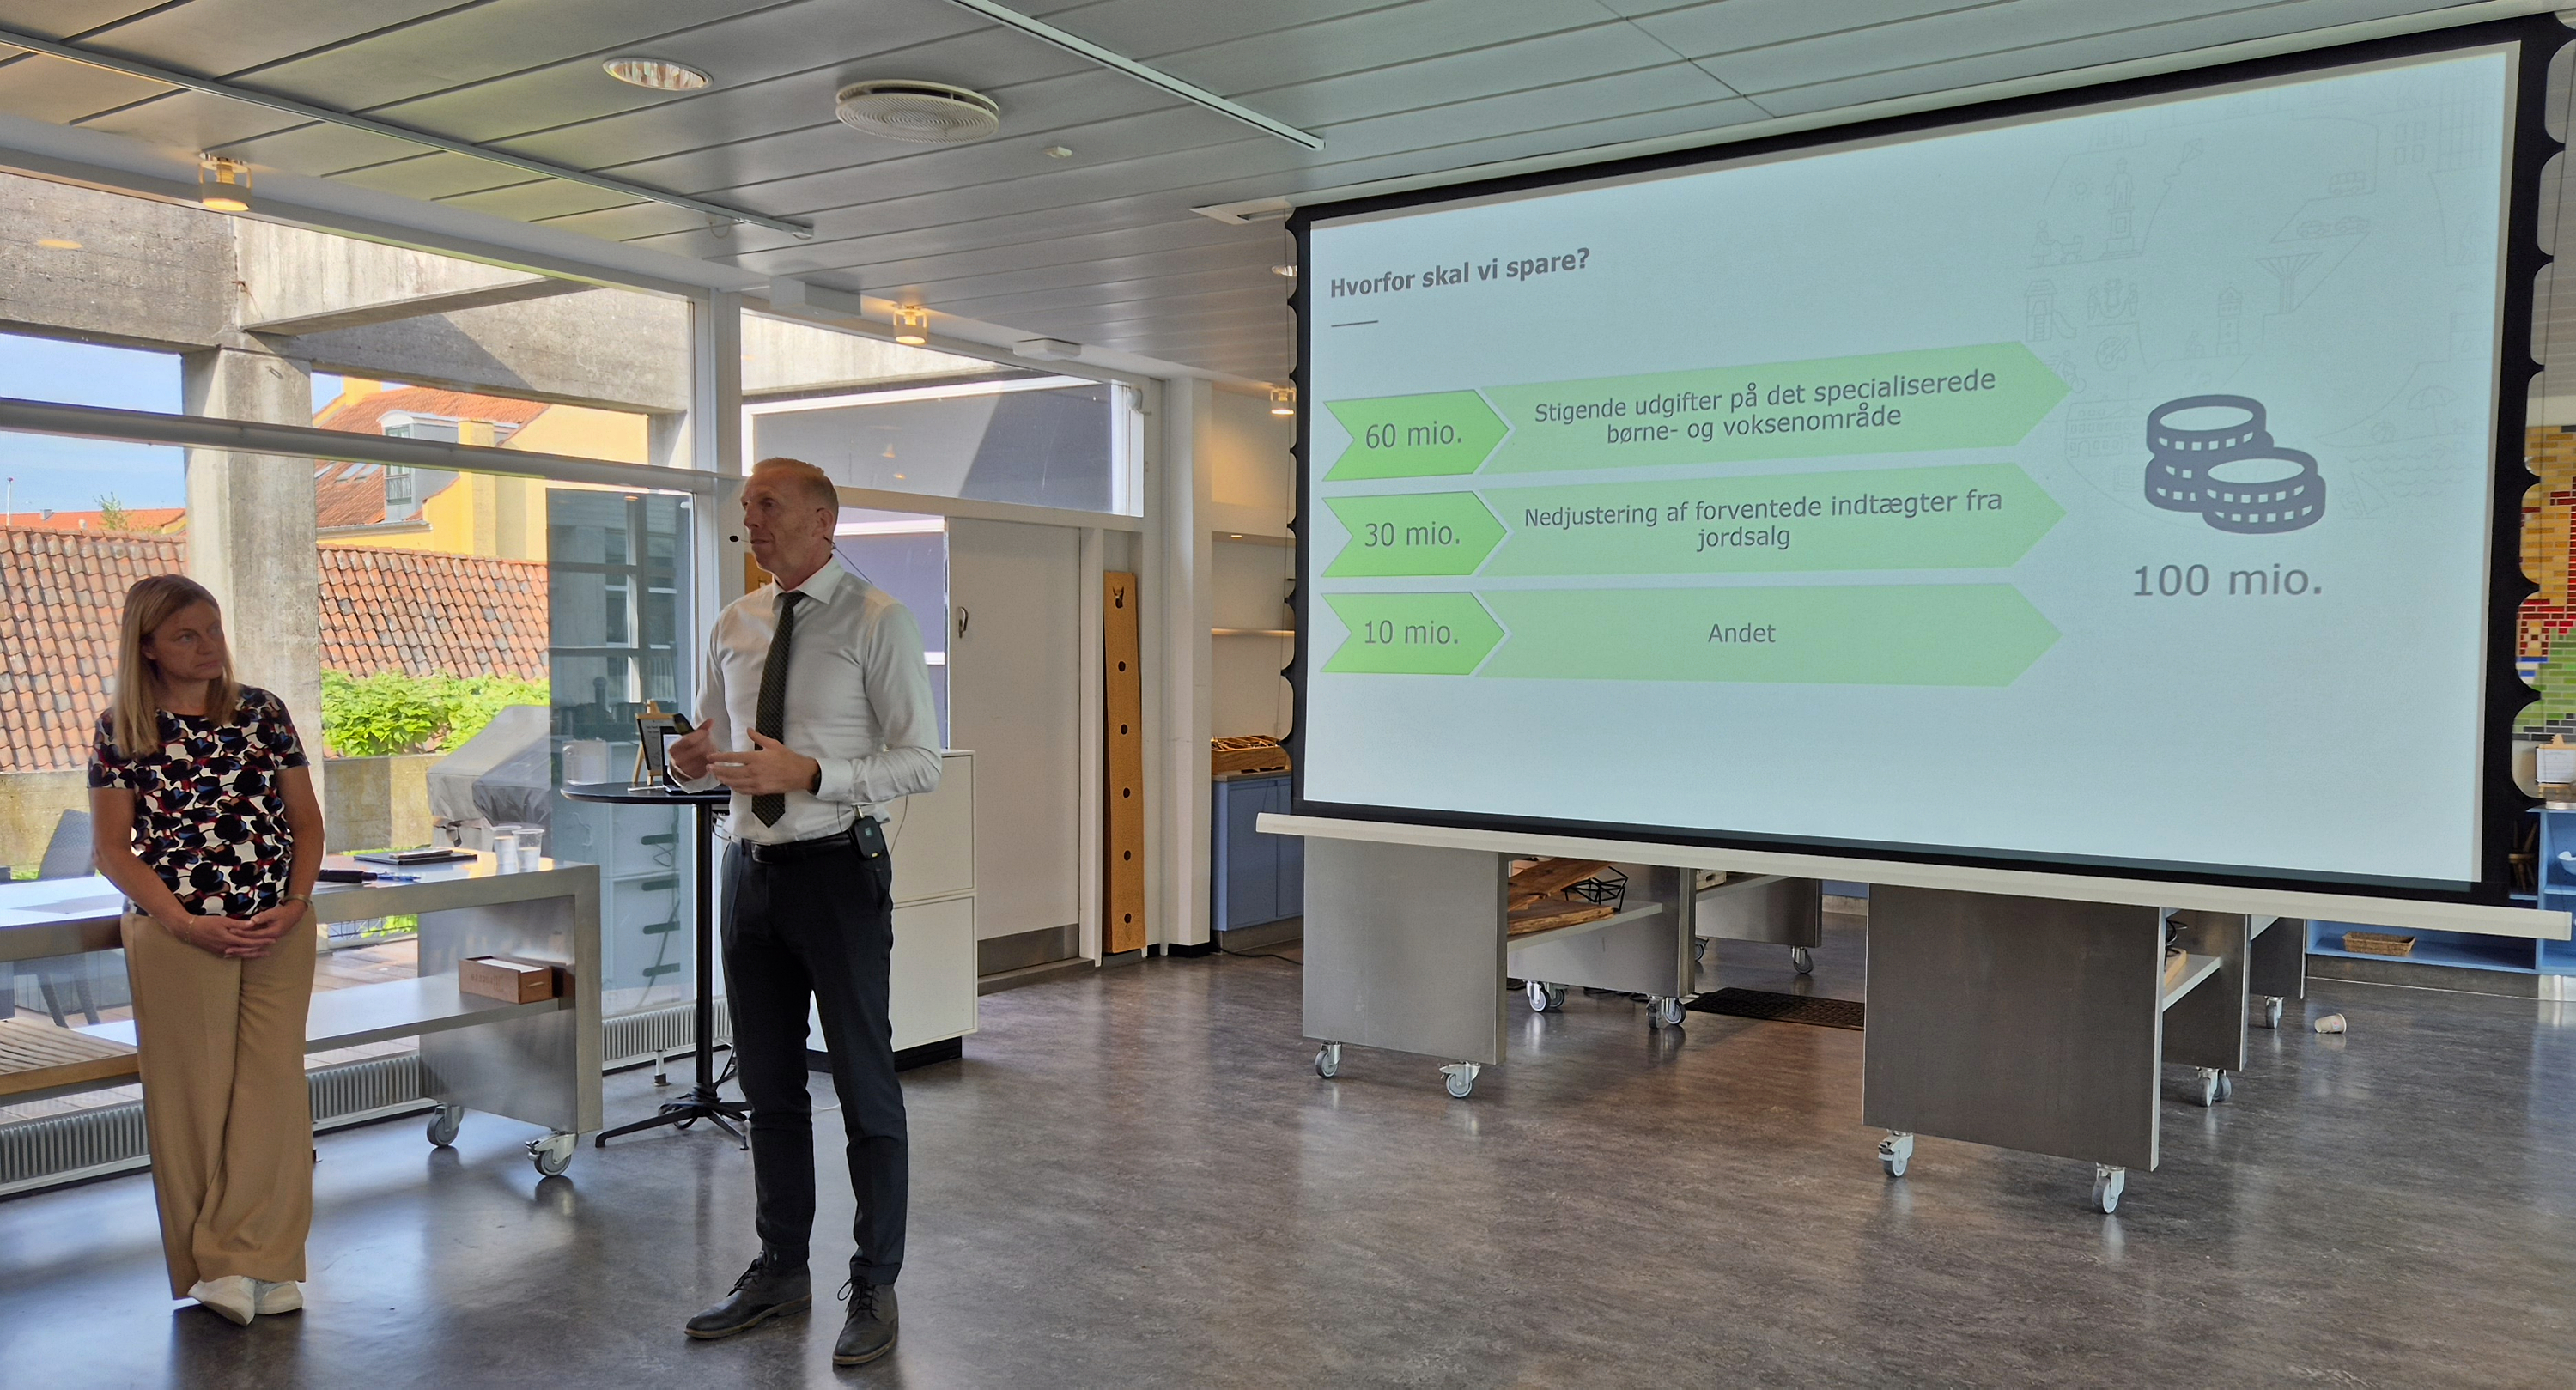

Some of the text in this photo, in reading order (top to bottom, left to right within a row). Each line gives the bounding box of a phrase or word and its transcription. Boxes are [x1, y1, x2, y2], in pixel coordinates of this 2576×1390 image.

[1330, 246, 1590, 299] Hvorfor skal vi spare?
[1534, 368, 1996, 426] Stigende udgifter på det specialiserede
[1365, 421, 1462, 449] 60 mio.
[1607, 401, 1902, 445] børne- og voksenområde
[1525, 488, 2002, 531] Nedjustering af forventede indtægter fra
[1364, 520, 1461, 548] 30 mio.
[1696, 524, 1790, 553] jordsalg
[2133, 562, 2322, 598] 100 mio.
[1364, 619, 1459, 645] 10 mio.
[1707, 622, 1777, 643] Andet
